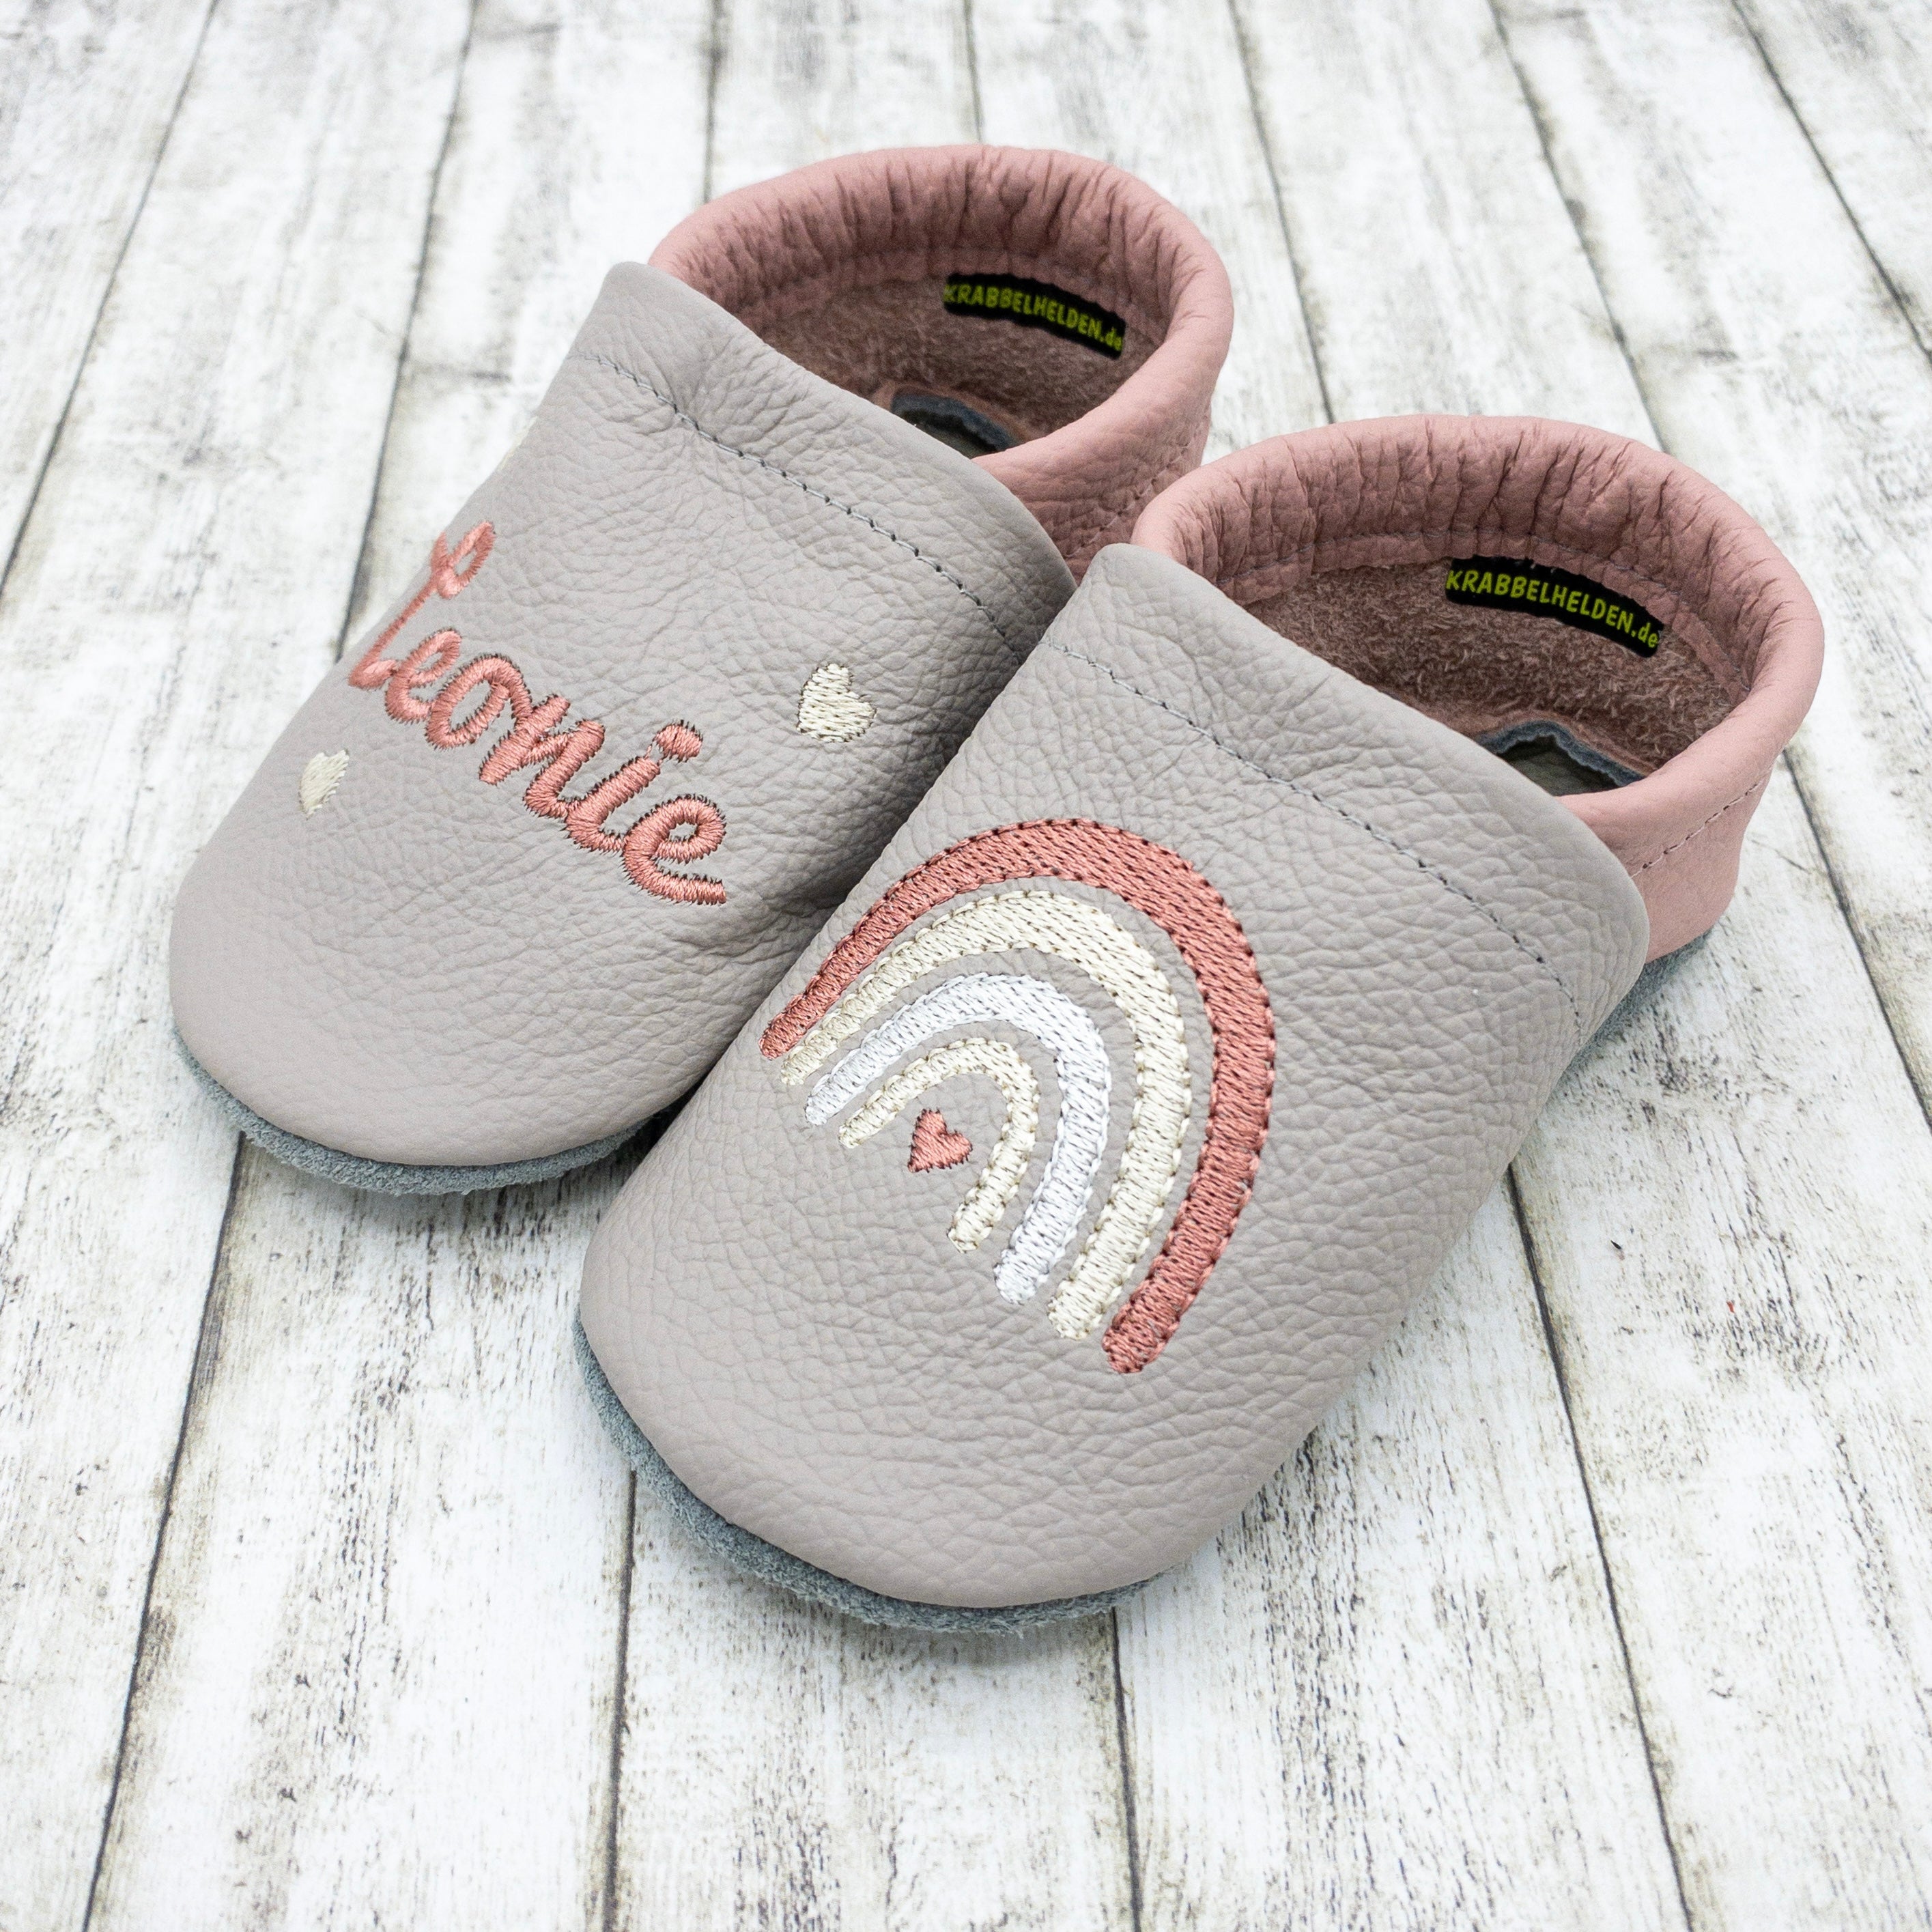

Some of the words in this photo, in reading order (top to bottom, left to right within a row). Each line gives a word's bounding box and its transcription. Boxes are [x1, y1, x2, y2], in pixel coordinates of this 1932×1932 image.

[943, 283, 1123, 352] KRABBELHELDEN.de
[1445, 569, 1659, 648] KRABBELHELDEN.de
[348, 520, 727, 905] Leonie
